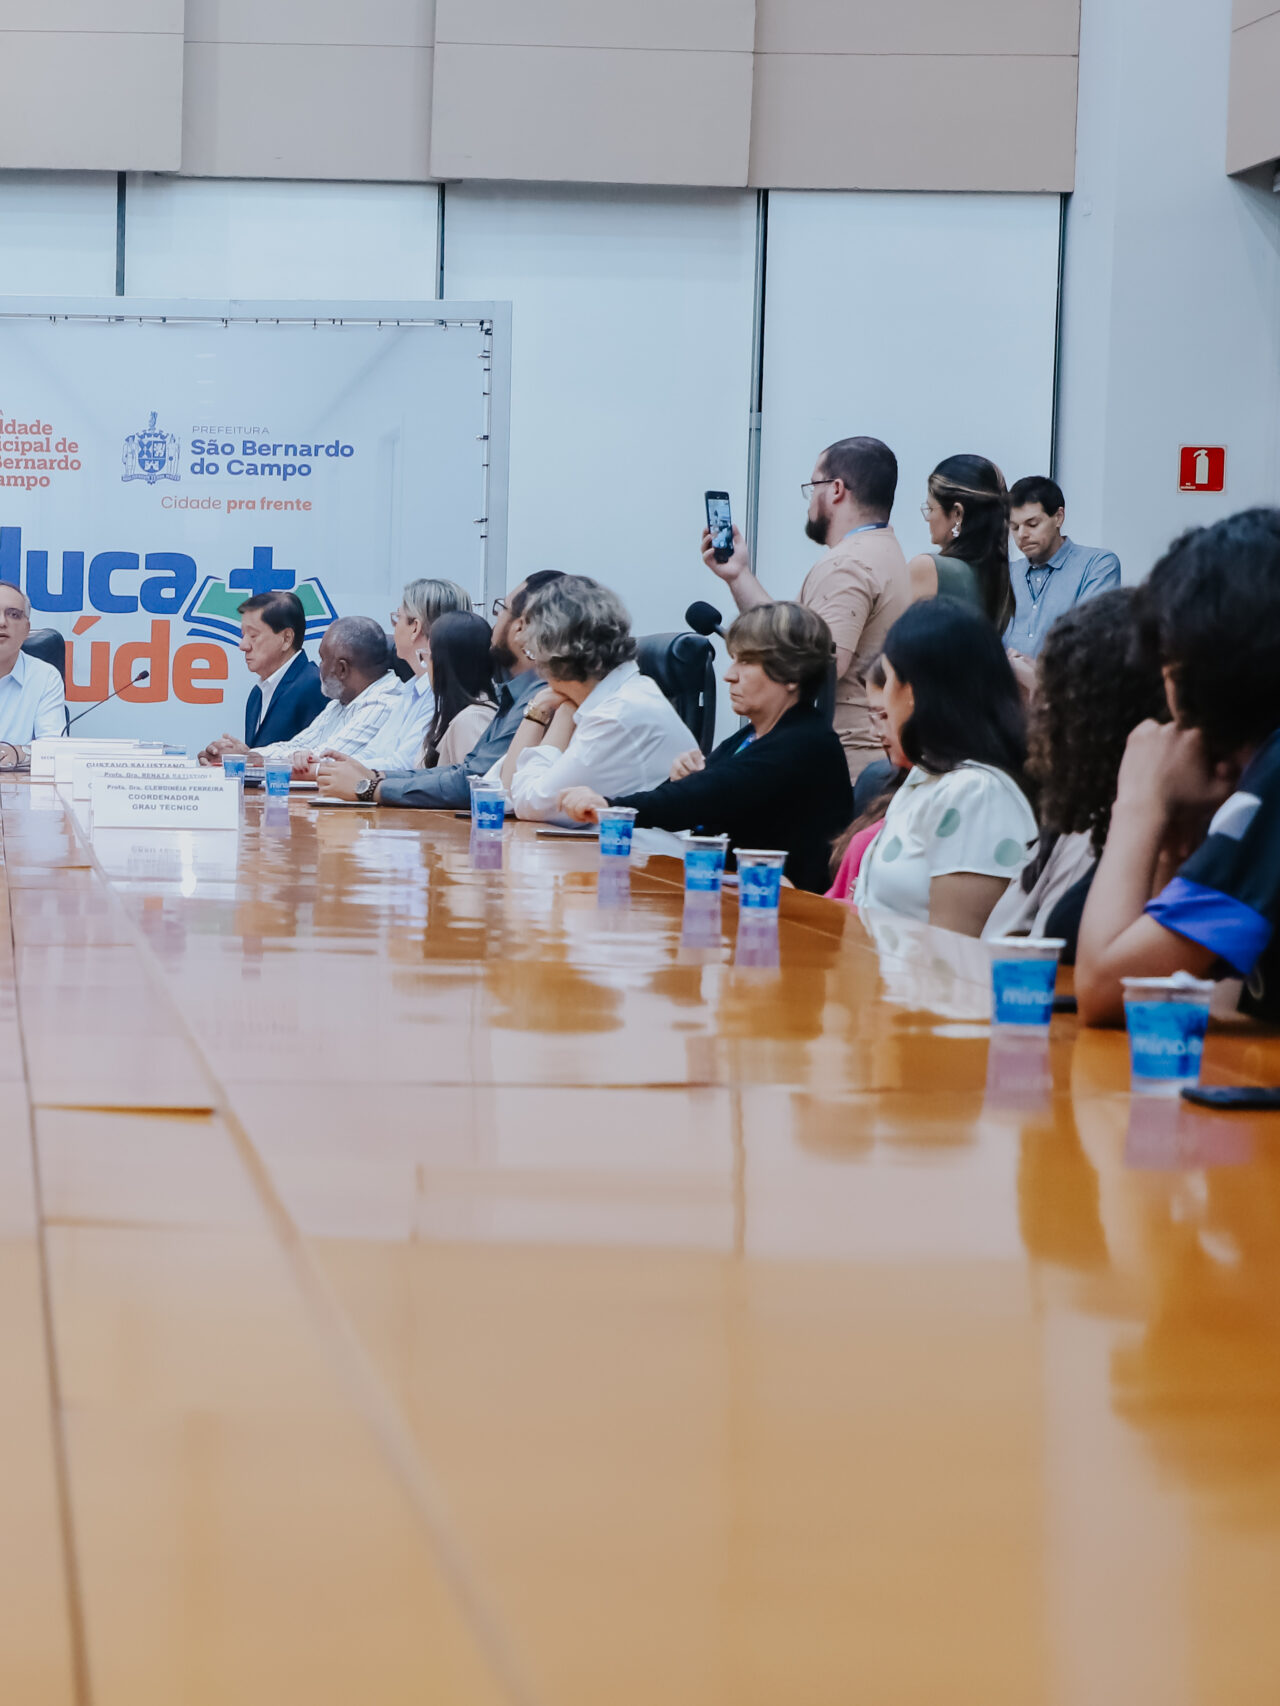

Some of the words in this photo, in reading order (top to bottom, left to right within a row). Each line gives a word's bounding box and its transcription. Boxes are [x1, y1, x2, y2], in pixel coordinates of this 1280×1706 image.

[192, 425, 270, 435] PREFEITURA
[55, 438, 79, 453] de
[190, 439, 235, 456] São
[242, 440, 355, 457] Bernardo
[190, 458, 220, 475] do
[226, 459, 312, 481] Campo
[161, 495, 222, 510] Cidade
[226, 499, 256, 514] pra
[260, 497, 312, 511] frente
[128, 793, 200, 801] COORDENADORA
